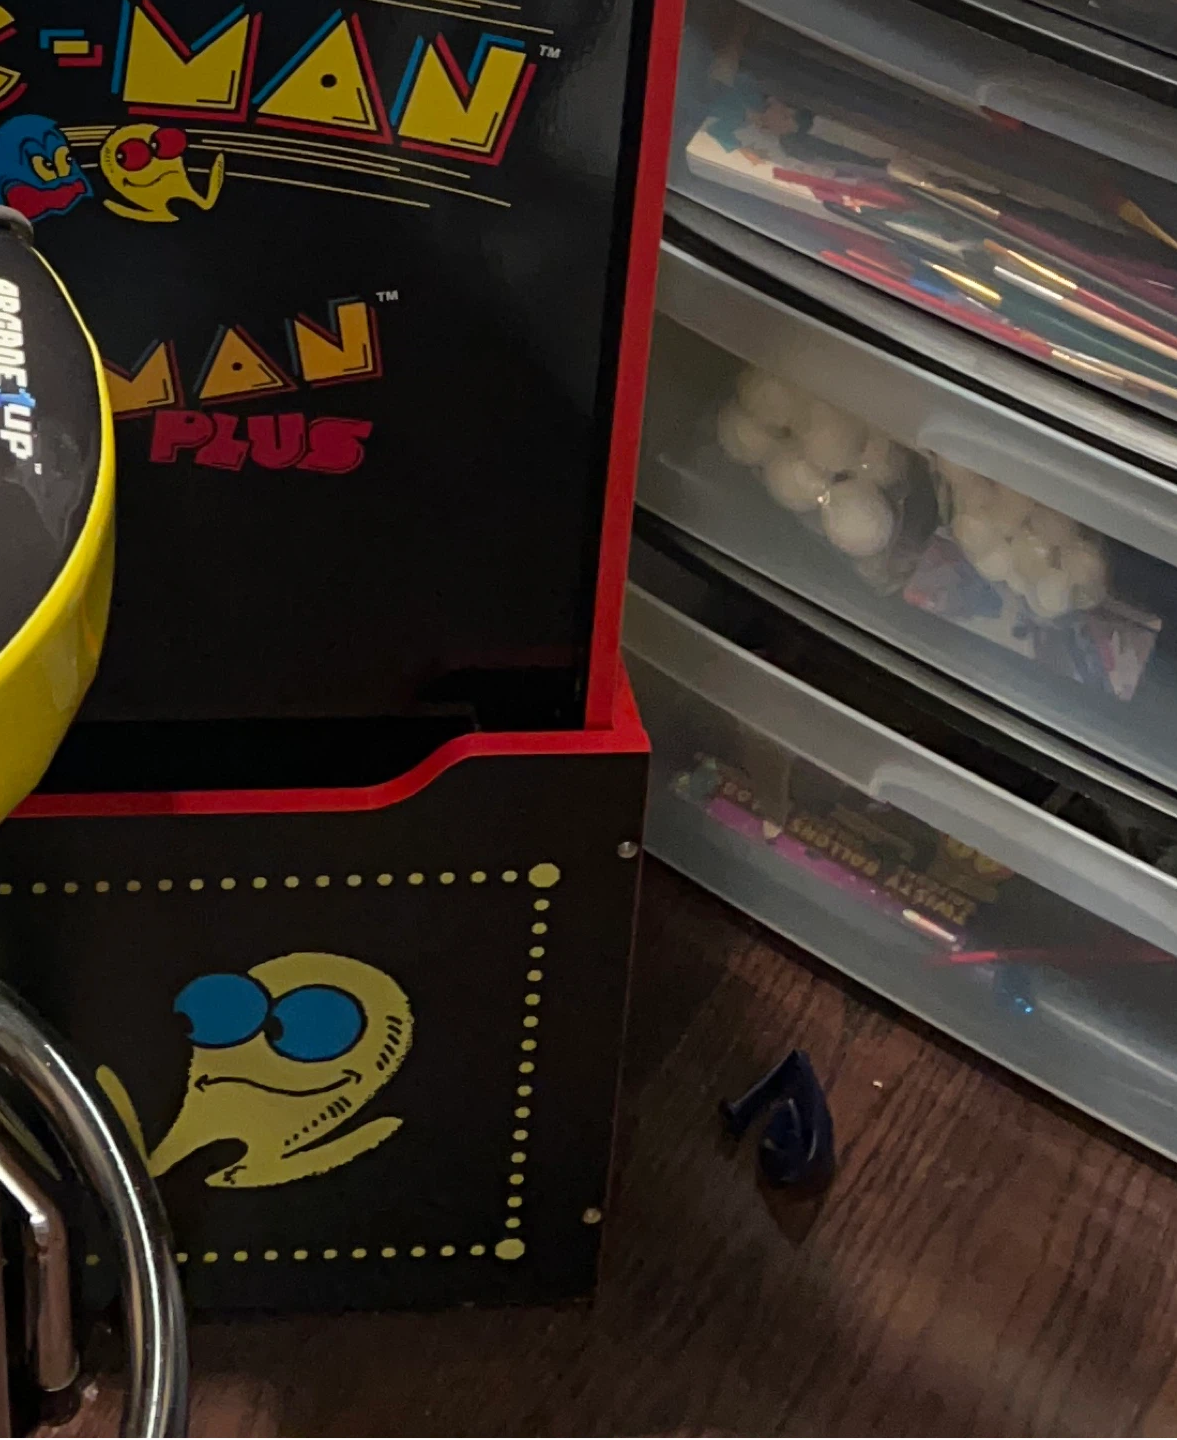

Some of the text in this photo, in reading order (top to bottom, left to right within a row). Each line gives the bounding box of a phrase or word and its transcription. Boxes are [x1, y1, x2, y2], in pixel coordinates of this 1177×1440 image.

[539, 44, 561, 59] TM
[377, 290, 399, 302] TM
[150, 410, 373, 474] PLUS
